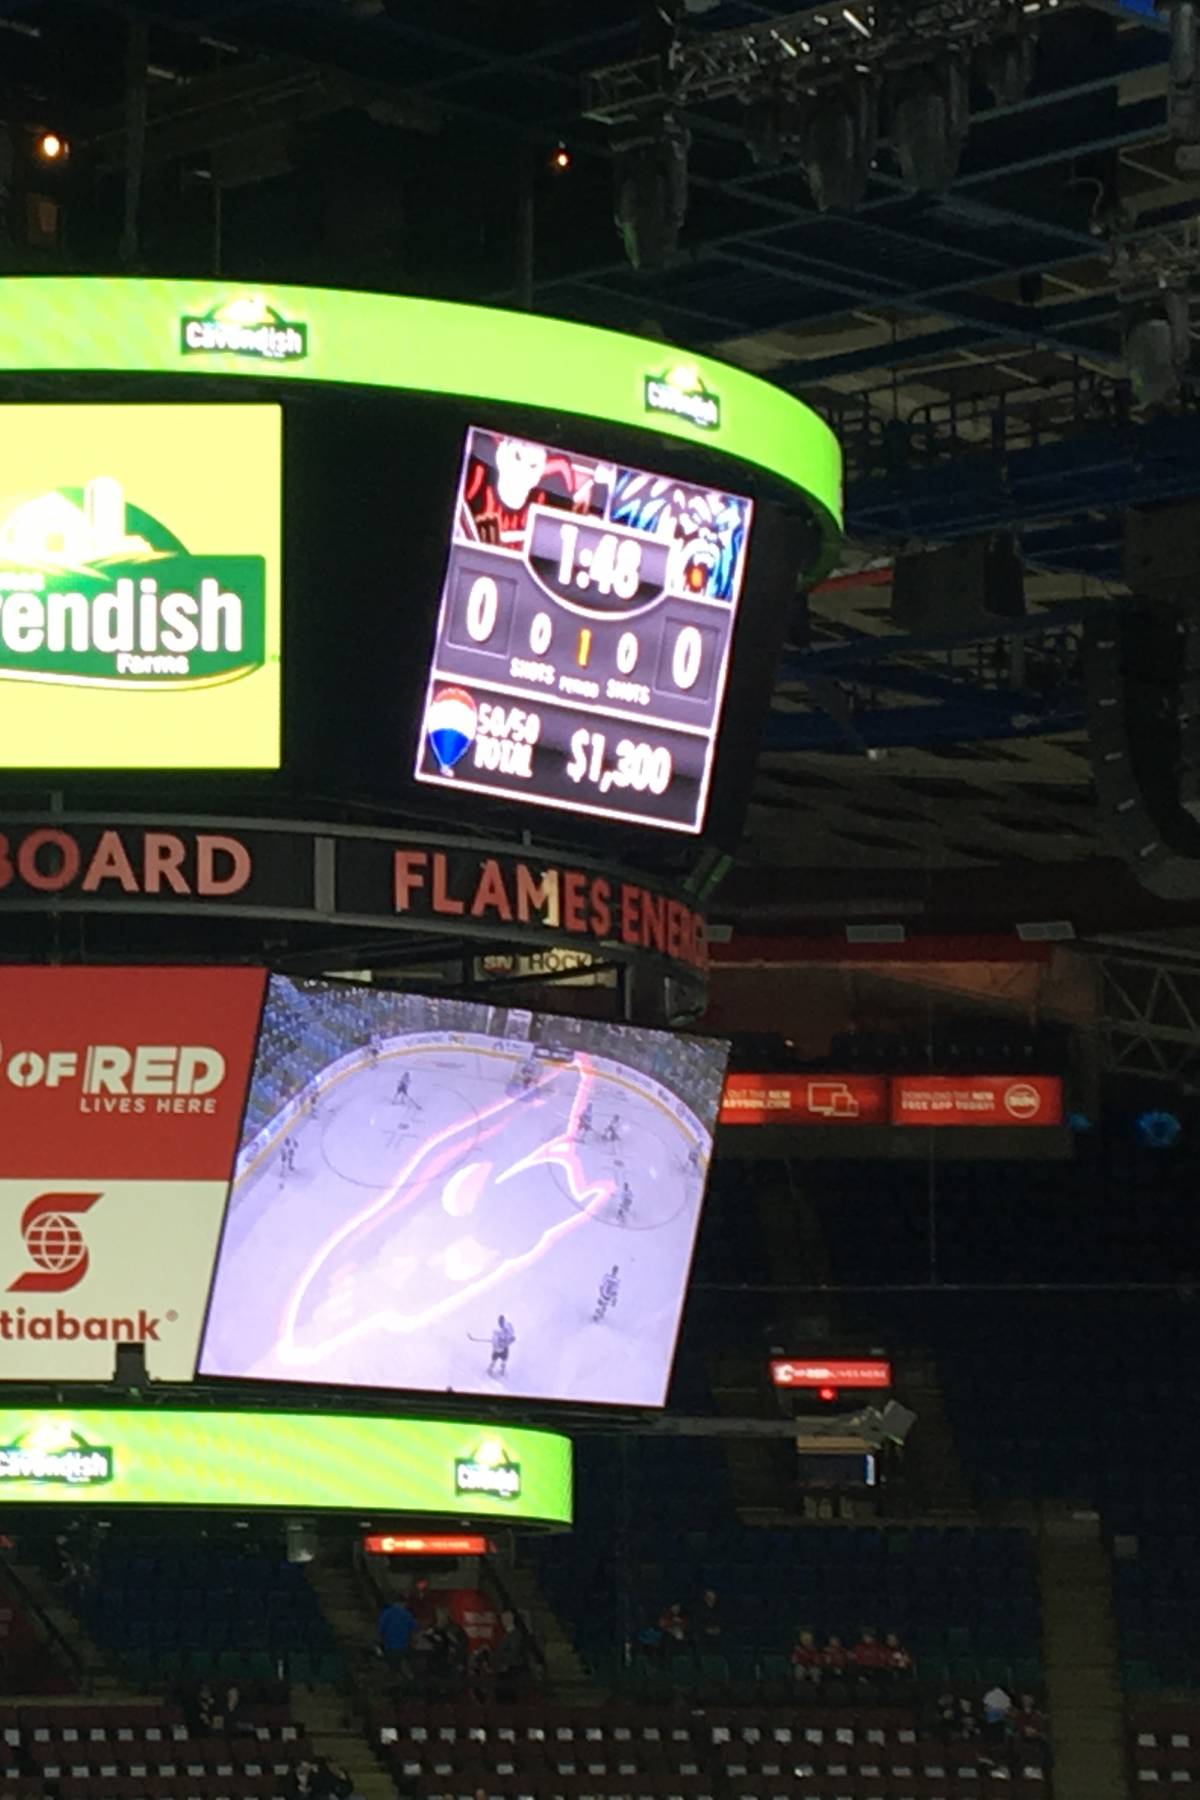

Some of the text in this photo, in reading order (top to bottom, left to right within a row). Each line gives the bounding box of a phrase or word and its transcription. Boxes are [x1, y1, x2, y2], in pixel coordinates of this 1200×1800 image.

[558, 523, 642, 599] 1:48
[466, 576, 497, 641] 0
[530, 612, 551, 654] 0
[616, 632, 638, 673] 0
[672, 626, 701, 689] 0
[566, 728, 672, 794] $1,300
[393, 849, 611, 935] FLAMES
[6, 1051, 78, 1088] OF
[82, 1045, 226, 1096] RED
[79, 1097, 218, 1115] LIVES HERE
